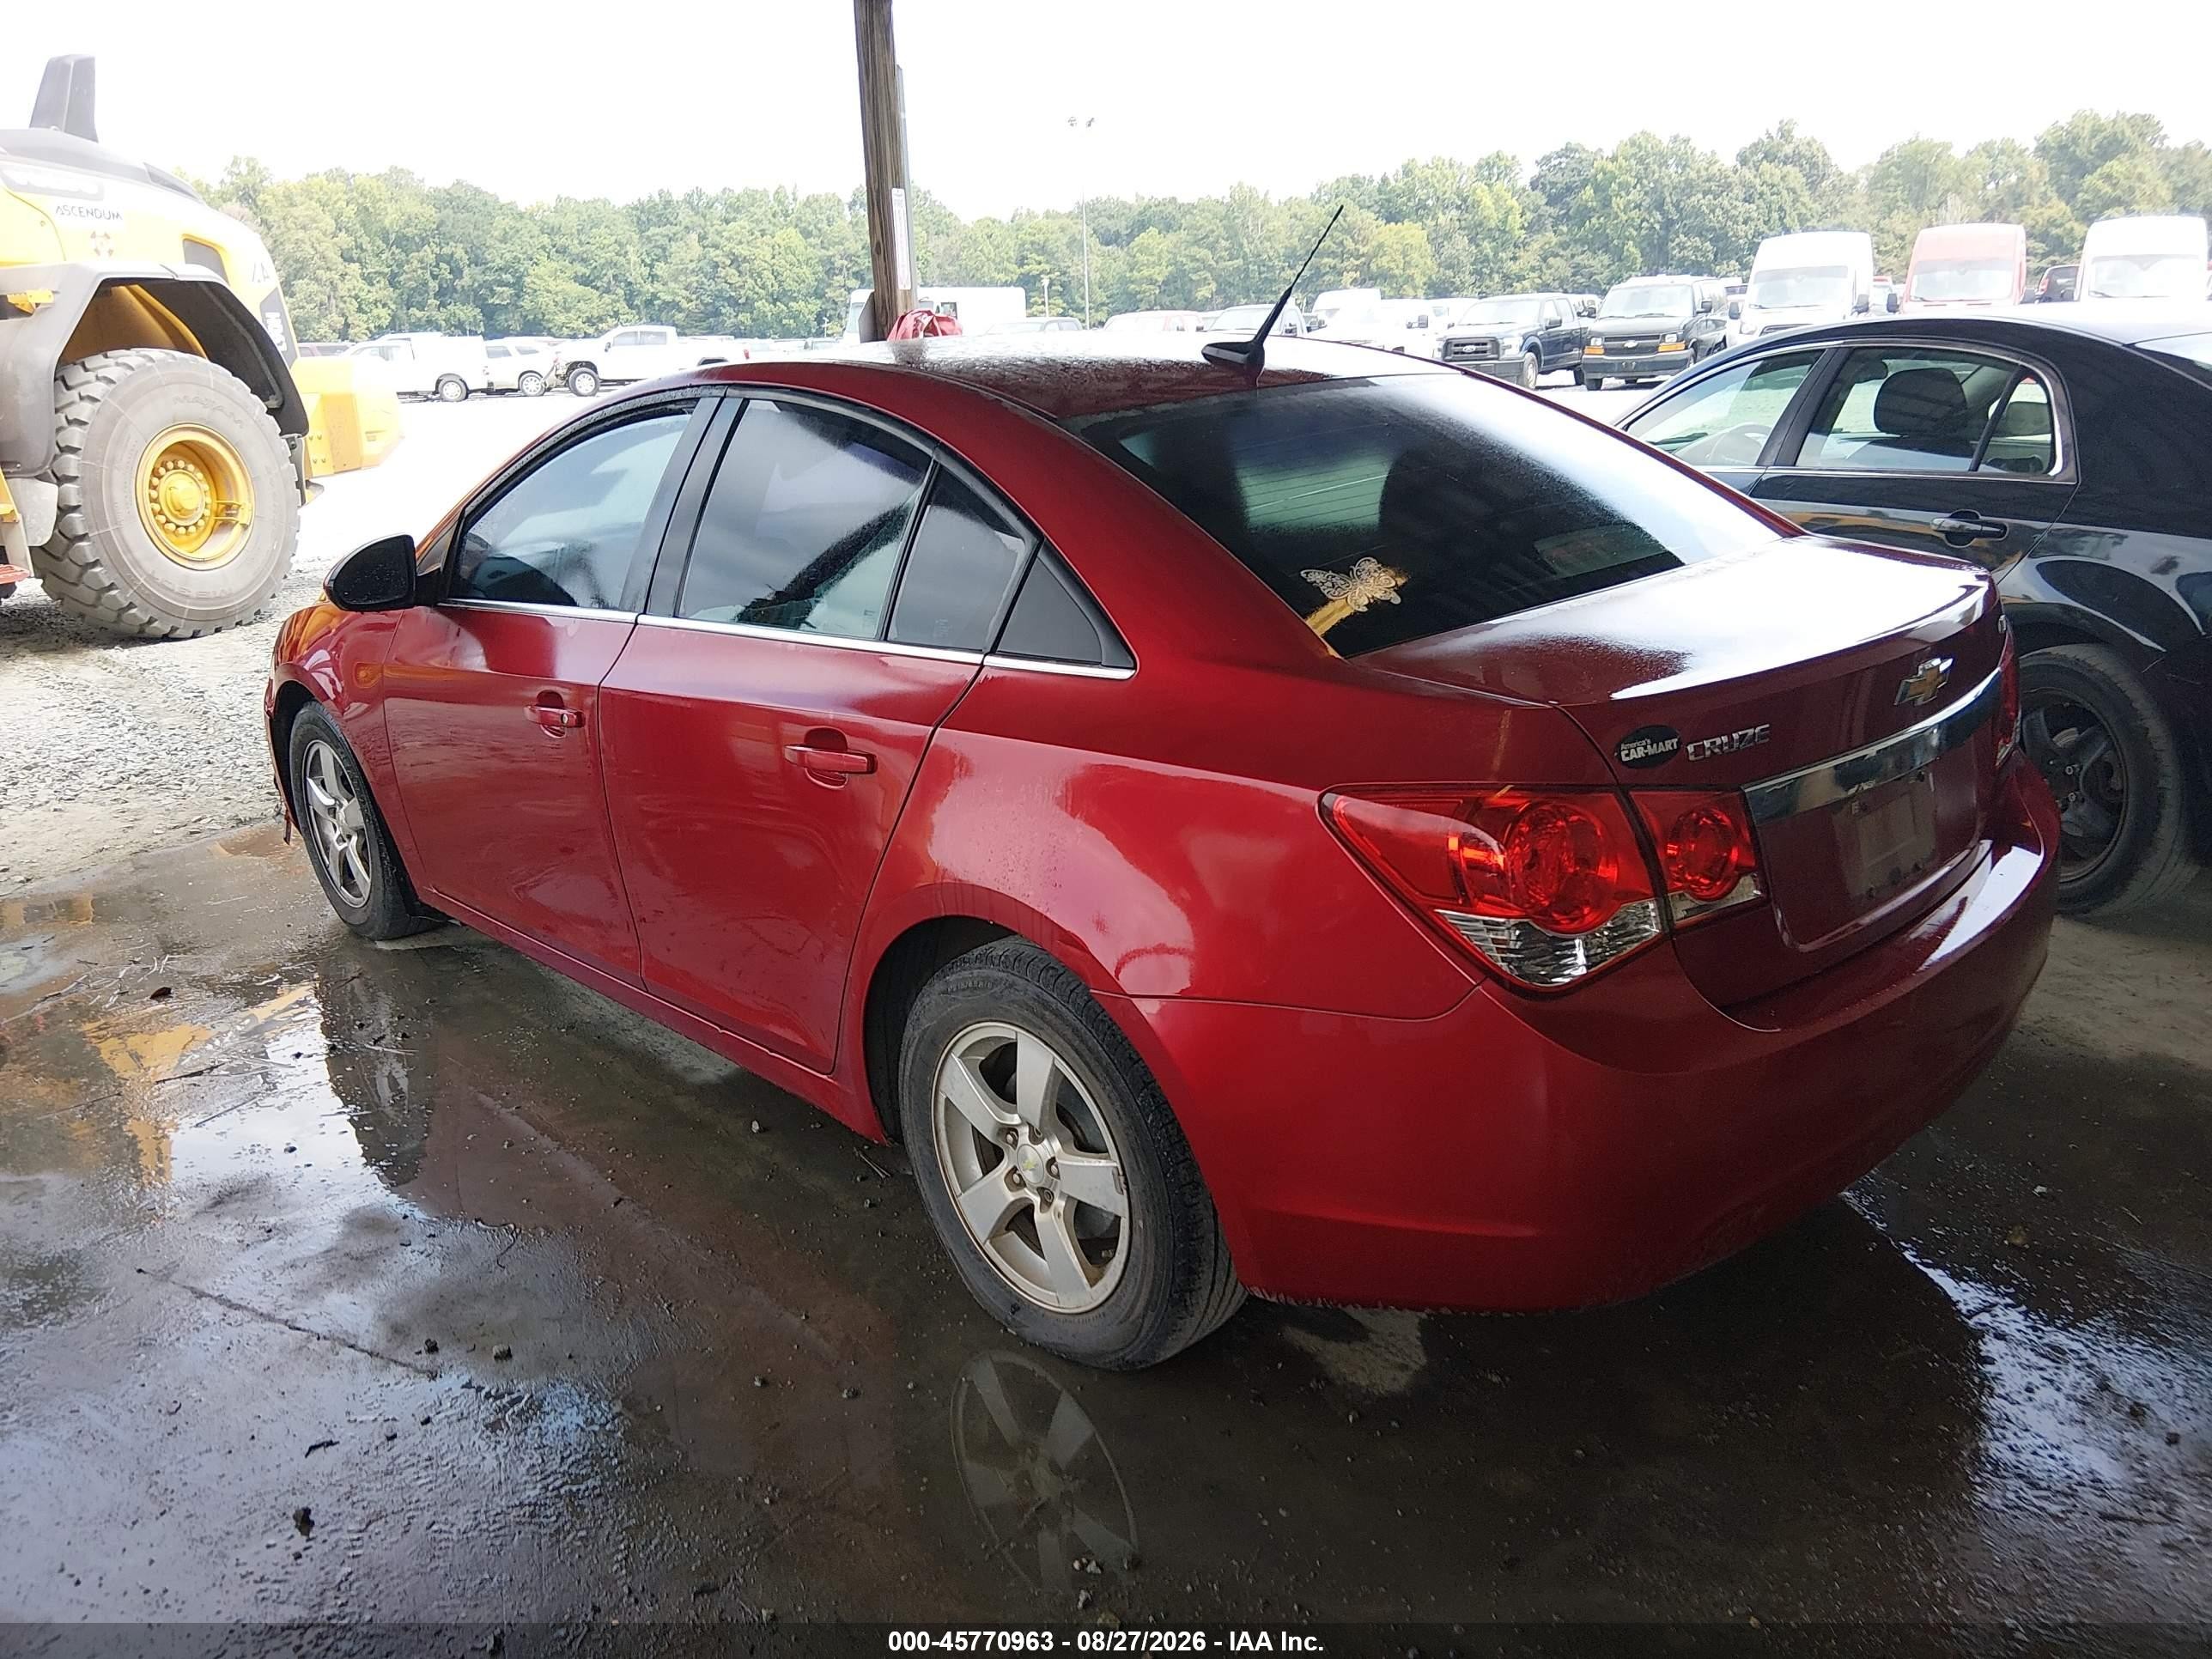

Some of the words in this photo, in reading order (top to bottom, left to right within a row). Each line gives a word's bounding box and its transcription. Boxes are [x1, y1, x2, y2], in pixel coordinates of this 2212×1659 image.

[56, 204, 123, 220] ASCENDUM
[1620, 738, 1651, 750] America's
[1620, 738, 1678, 762] CAR-MART
[1686, 724, 1770, 761] CRUZE
